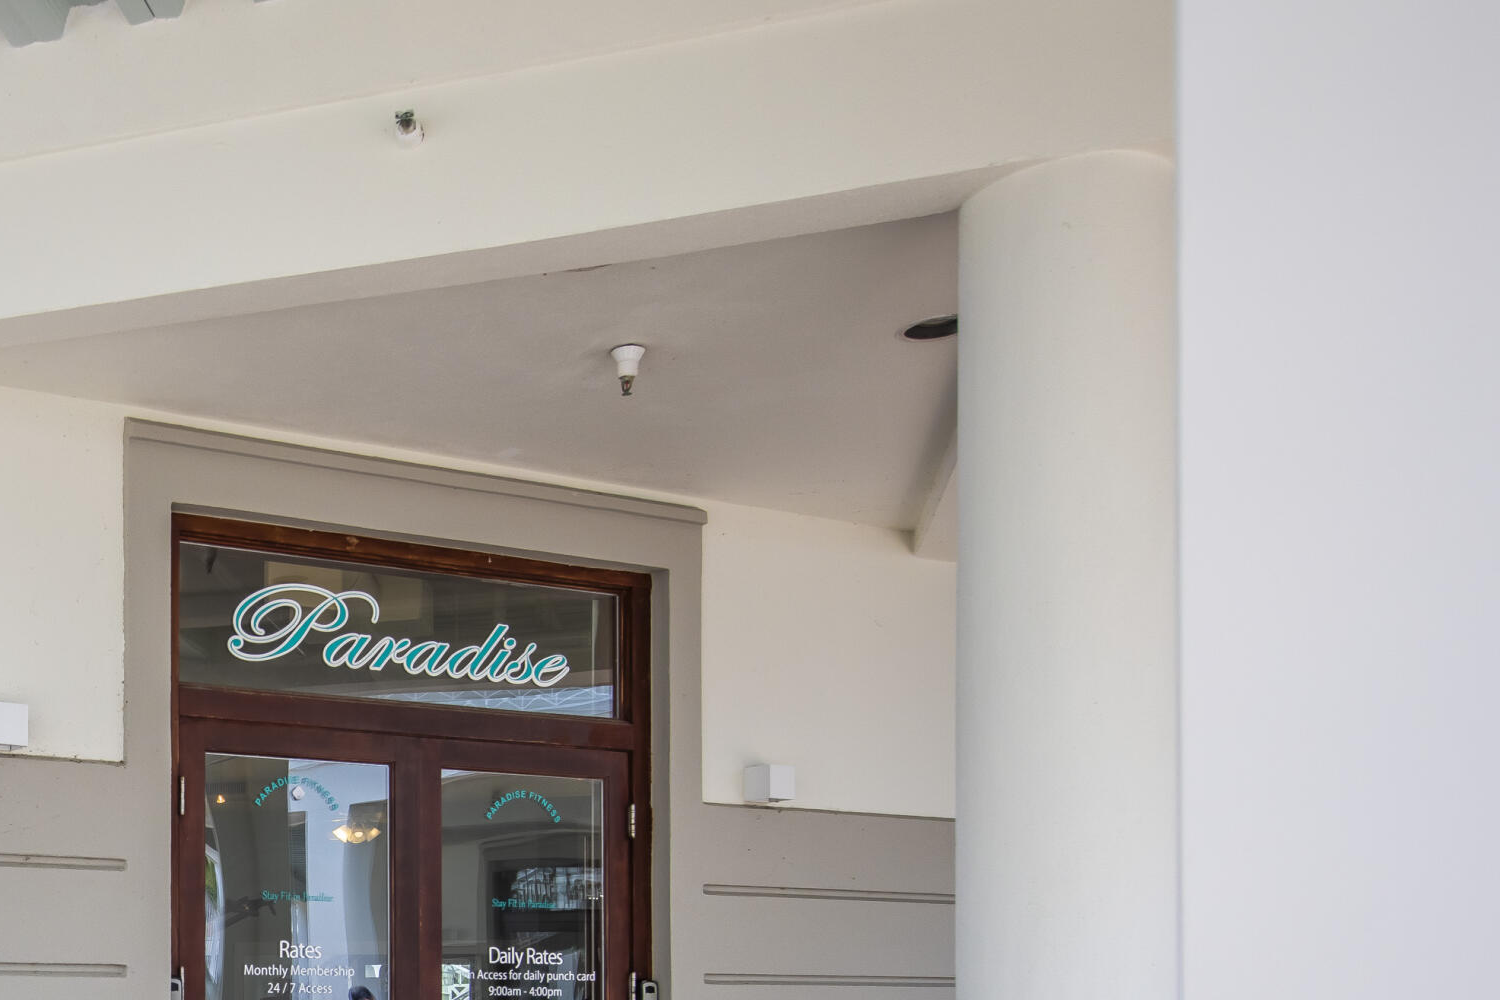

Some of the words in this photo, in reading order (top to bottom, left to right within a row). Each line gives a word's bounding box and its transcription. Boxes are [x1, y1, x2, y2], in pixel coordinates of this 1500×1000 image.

[227, 583, 570, 687] Paradise
[486, 789, 527, 821] PARADISE
[528, 790, 562, 824] FITNESS
[279, 940, 323, 959] Rates
[488, 946, 524, 969] Daily
[526, 947, 564, 966] Rates
[243, 964, 289, 979] Monthly
[290, 964, 356, 978] Membership
[476, 969, 508, 981] Access
[508, 969, 522, 981] for
[523, 970, 546, 984] daily
[546, 971, 575, 983] punch
[576, 970, 596, 982] card
[267, 982, 281, 994] 24
[290, 982, 296, 994] 7
[298, 982, 333, 994] Access
[488, 986, 522, 997] 9:00am
[529, 986, 563, 998] 4:00pm
